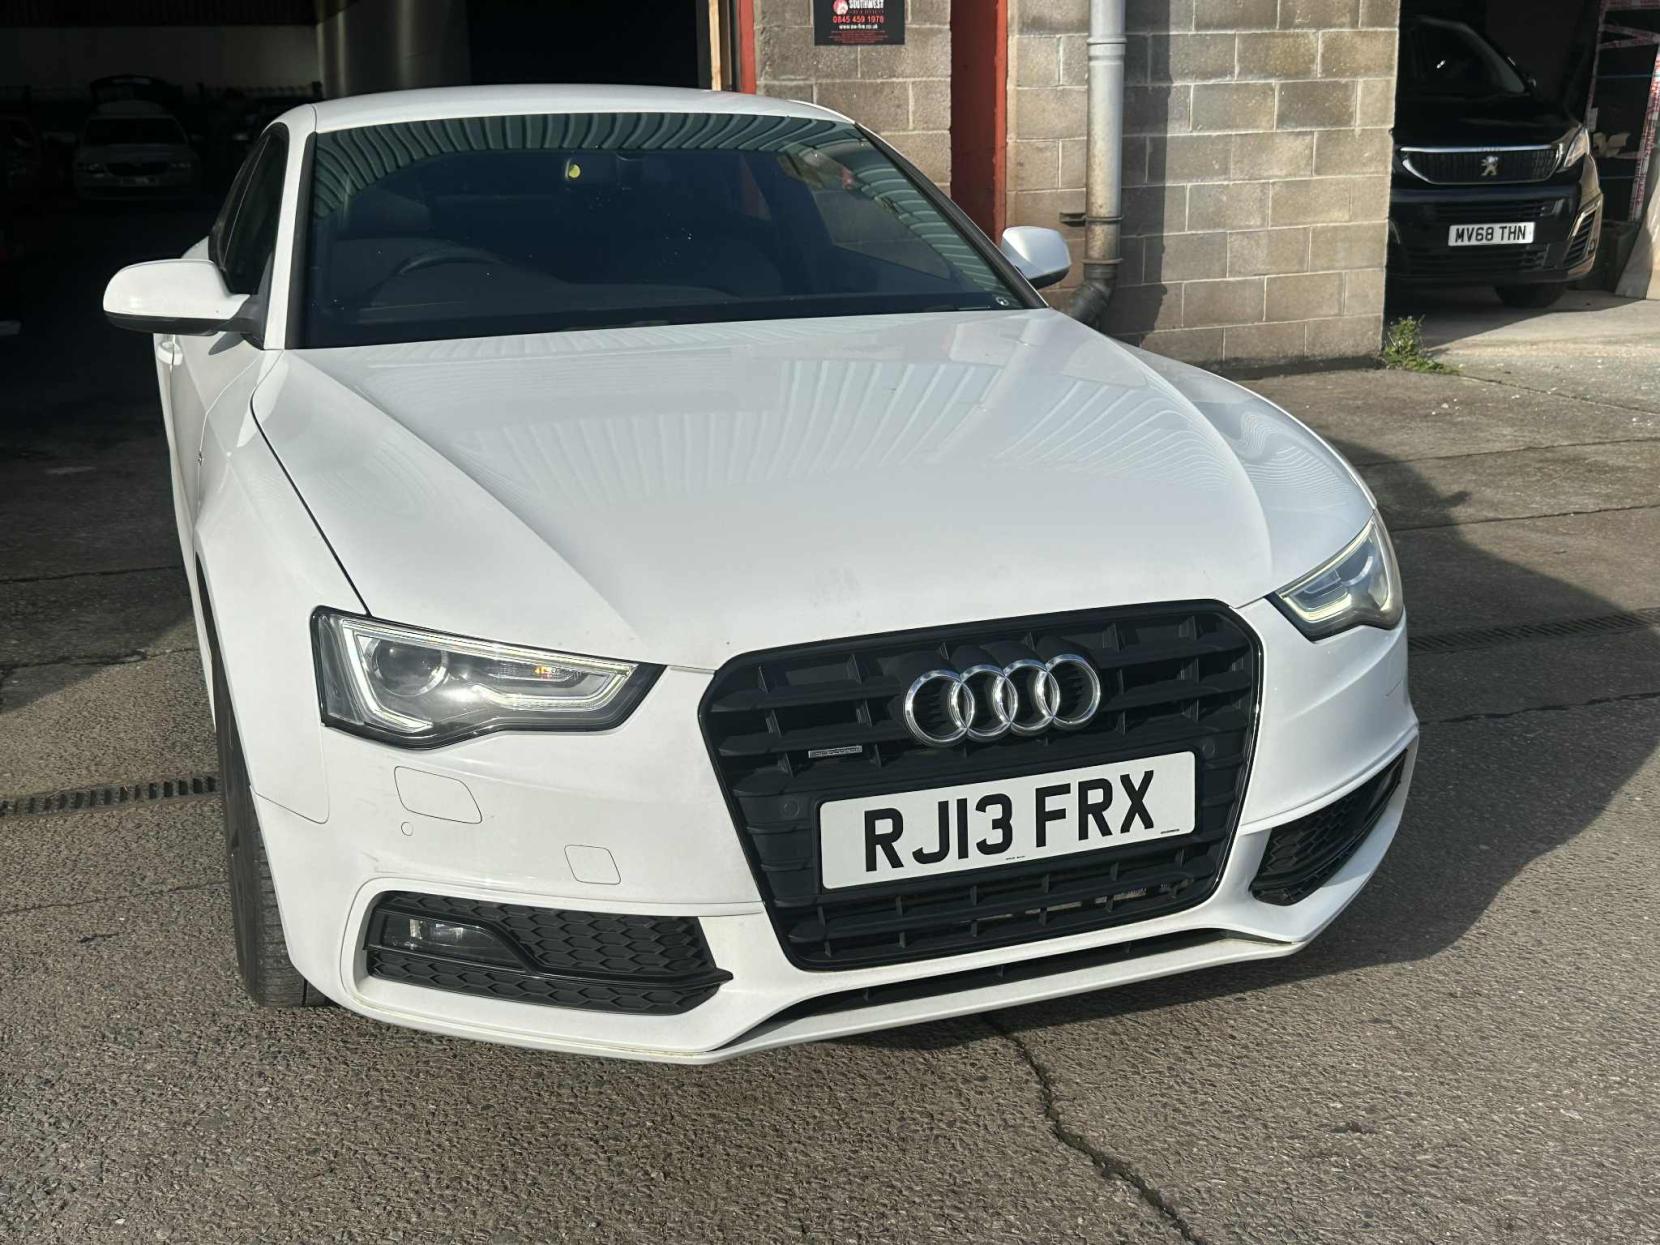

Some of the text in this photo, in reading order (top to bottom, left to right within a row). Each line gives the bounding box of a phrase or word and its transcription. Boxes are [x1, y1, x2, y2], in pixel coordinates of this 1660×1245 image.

[849, 0, 884, 9] SOUTHWEST
[1455, 225, 1526, 243] MV68 THN
[864, 770, 1154, 872] RJ13 FRX
